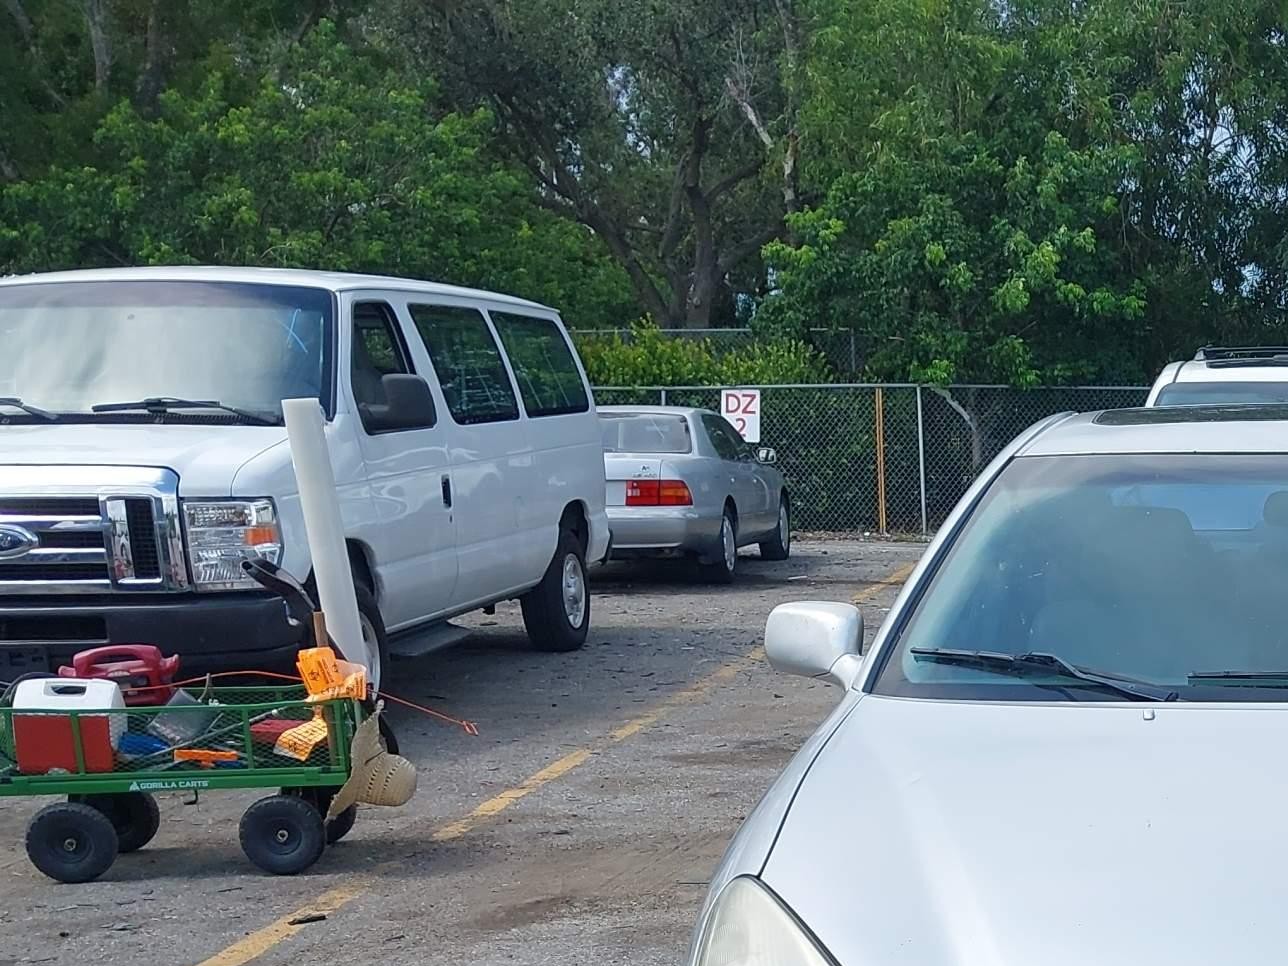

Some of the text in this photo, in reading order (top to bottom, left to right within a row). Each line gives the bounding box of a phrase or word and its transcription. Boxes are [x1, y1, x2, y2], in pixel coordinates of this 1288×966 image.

[725, 393, 757, 414] DZ
[735, 417, 747, 438] 2
[140, 780, 209, 790] GORILLA CARTS
